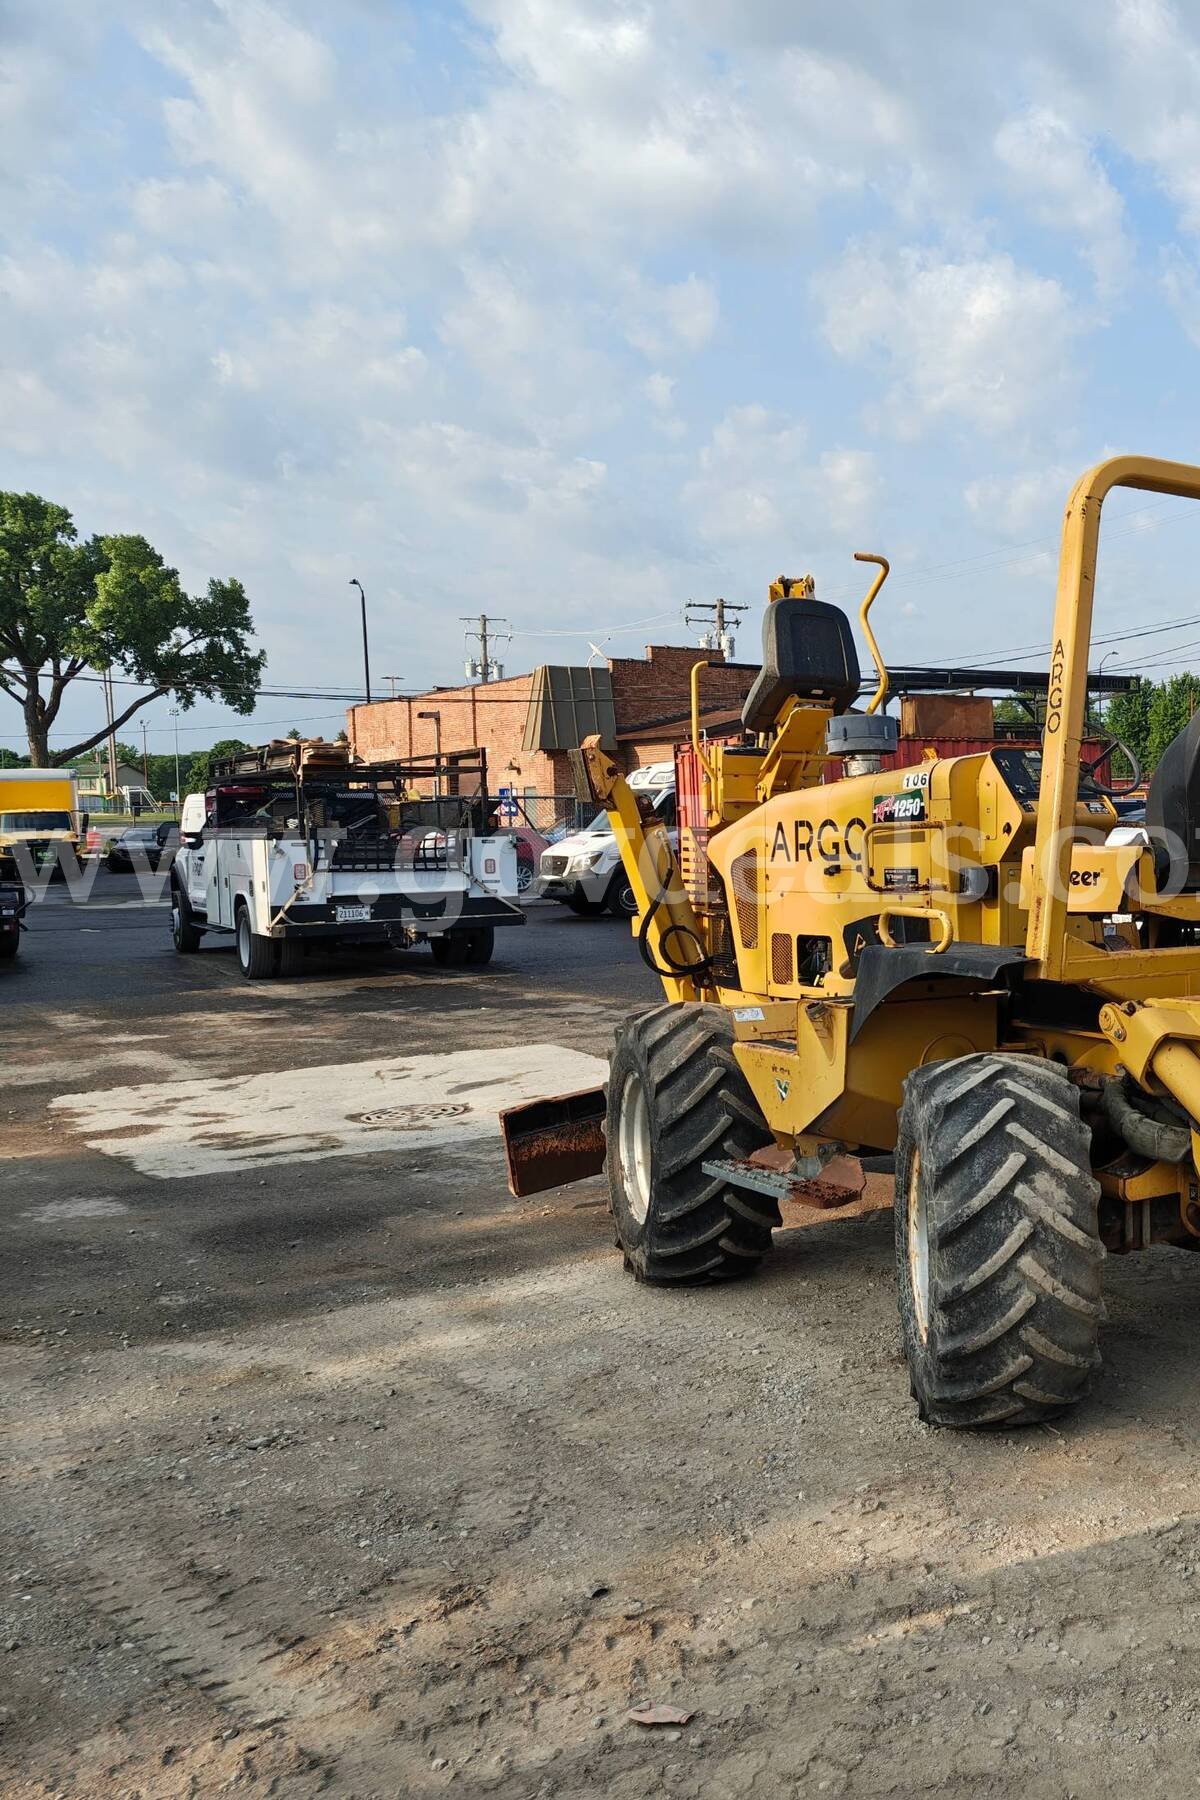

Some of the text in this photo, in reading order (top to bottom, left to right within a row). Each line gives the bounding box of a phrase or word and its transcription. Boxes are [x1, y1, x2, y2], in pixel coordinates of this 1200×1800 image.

[1047, 639, 1065, 734] ARGO
[905, 773, 928, 788] 106
[893, 798, 921, 818] 1250
[771, 817, 867, 862] ARGO
